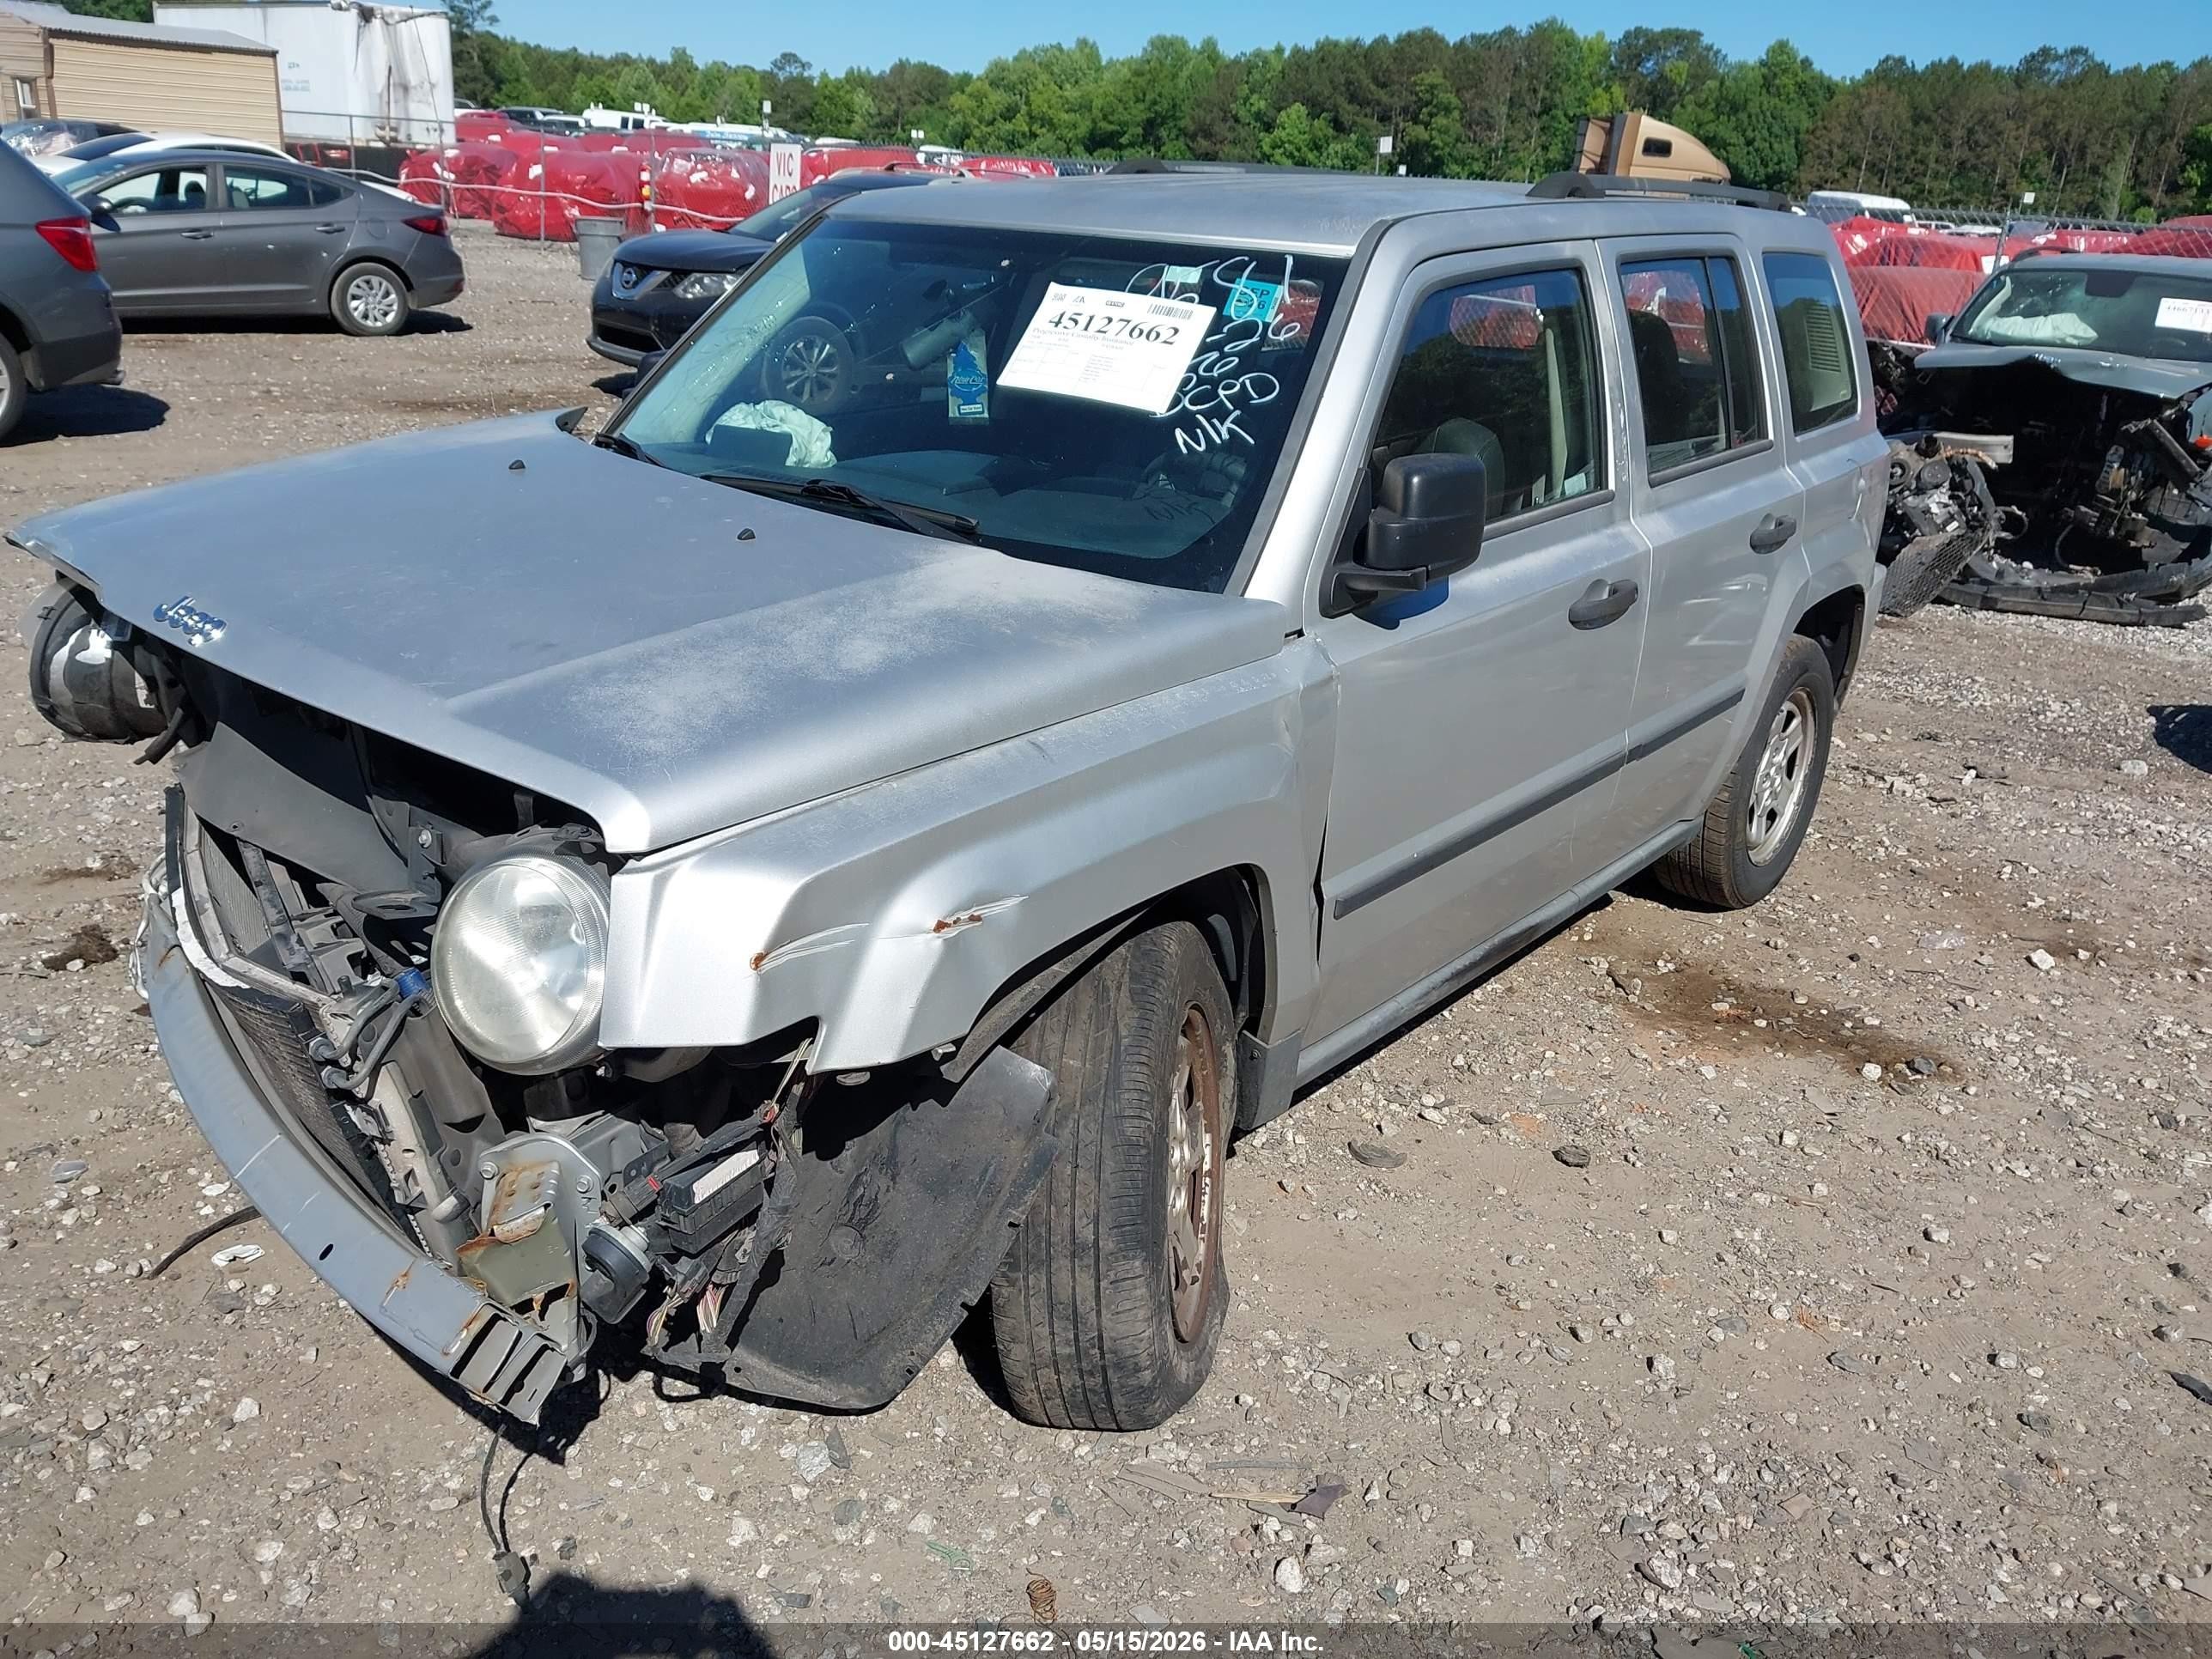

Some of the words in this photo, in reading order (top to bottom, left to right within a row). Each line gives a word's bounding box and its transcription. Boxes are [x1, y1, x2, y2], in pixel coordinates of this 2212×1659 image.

[776, 151, 794, 177] VIC
[1048, 310, 1180, 345] 45127662
[153, 595, 228, 647] Jeep
